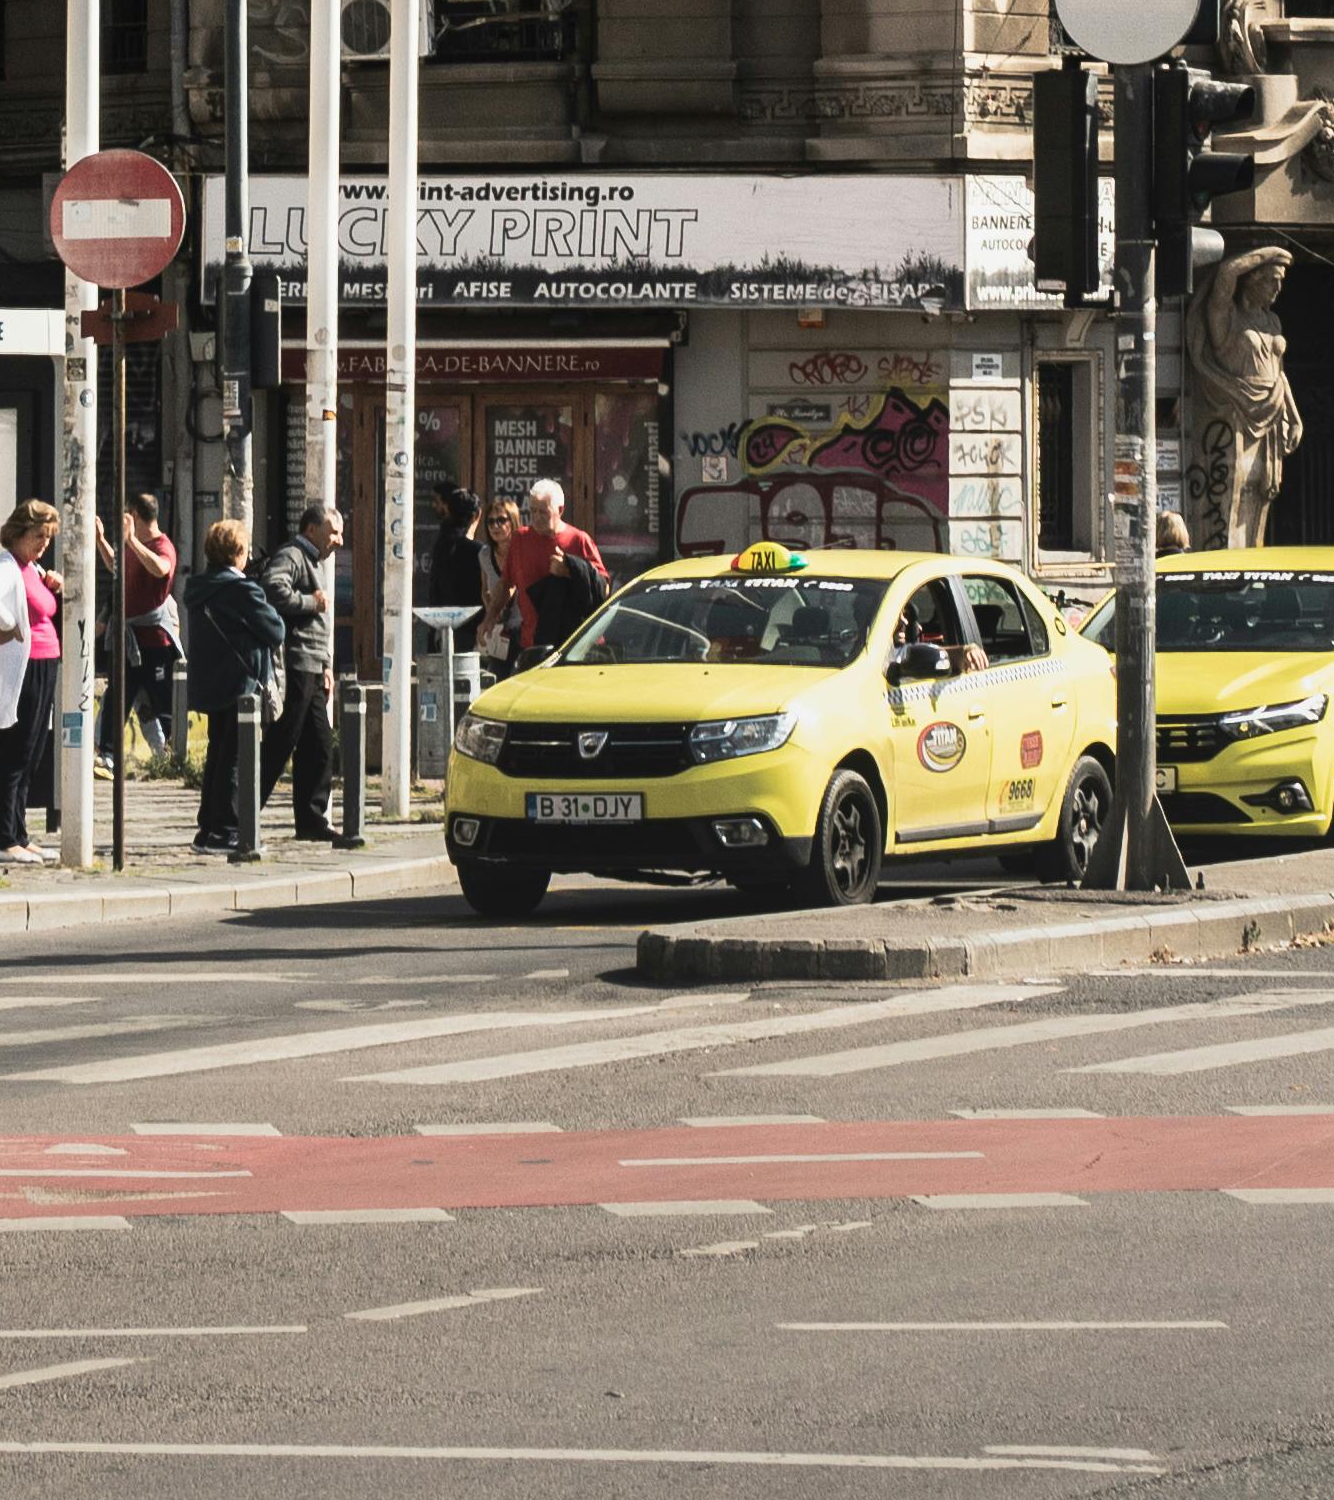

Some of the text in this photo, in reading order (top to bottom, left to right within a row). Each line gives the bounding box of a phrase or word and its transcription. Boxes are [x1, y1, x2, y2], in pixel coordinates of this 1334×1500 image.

[339, 182, 635, 207] ww.int-advertising.ro
[489, 208, 698, 258] PRINT
[452, 281, 513, 299] AFISE
[533, 282, 697, 300] AUTOCOLANTE
[730, 282, 818, 300] SISTEME
[823, 283, 848, 300] de
[494, 420, 537, 436] MESH
[494, 440, 556, 456] BANNER
[494, 458, 538, 474] AFISE
[494, 476, 562, 493] POST
[750, 551, 777, 572] TAXI
[699, 578, 741, 589] TAXI
[744, 578, 800, 589] TITAN
[1202, 571, 1241, 581] TAXI
[1243, 571, 1295, 581] TITAN
[931, 726, 958, 747] TITAN
[1007, 779, 1034, 801] 9668
[540, 796, 633, 818] B 31 DJY
